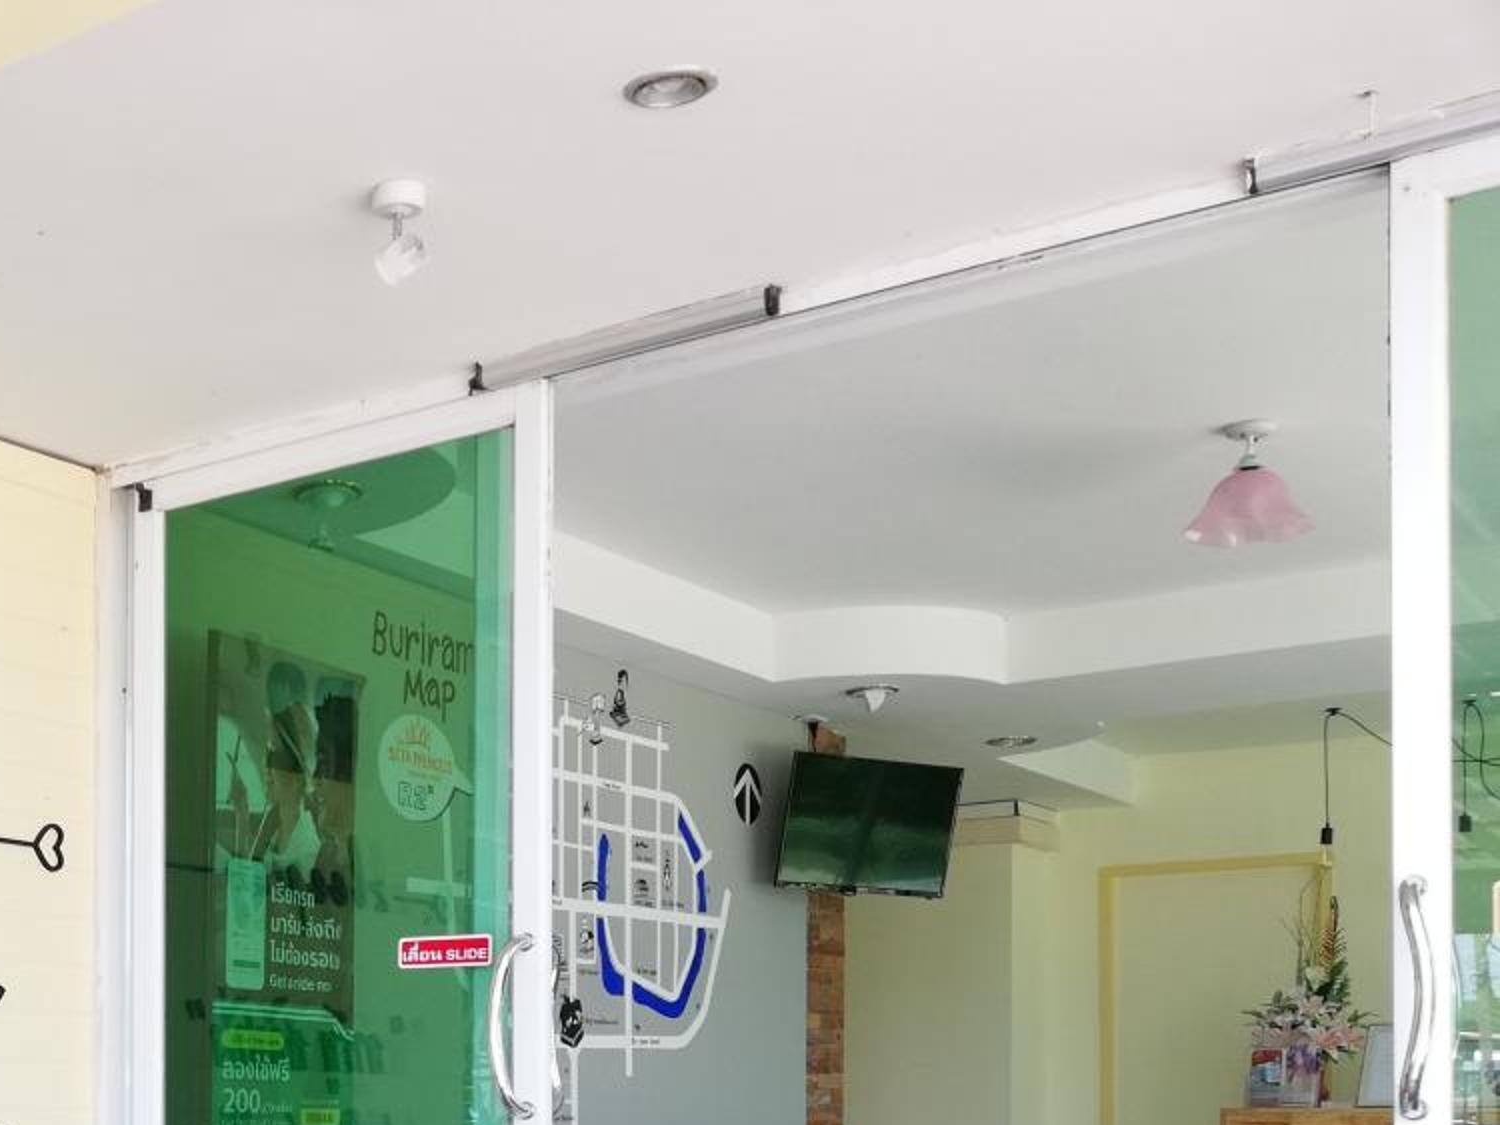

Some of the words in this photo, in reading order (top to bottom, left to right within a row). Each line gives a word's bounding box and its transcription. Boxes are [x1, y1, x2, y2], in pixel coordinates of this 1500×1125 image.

[403, 668, 456, 723] Map
[445, 947, 488, 962] SLIDE
[223, 1087, 262, 1114] 200
